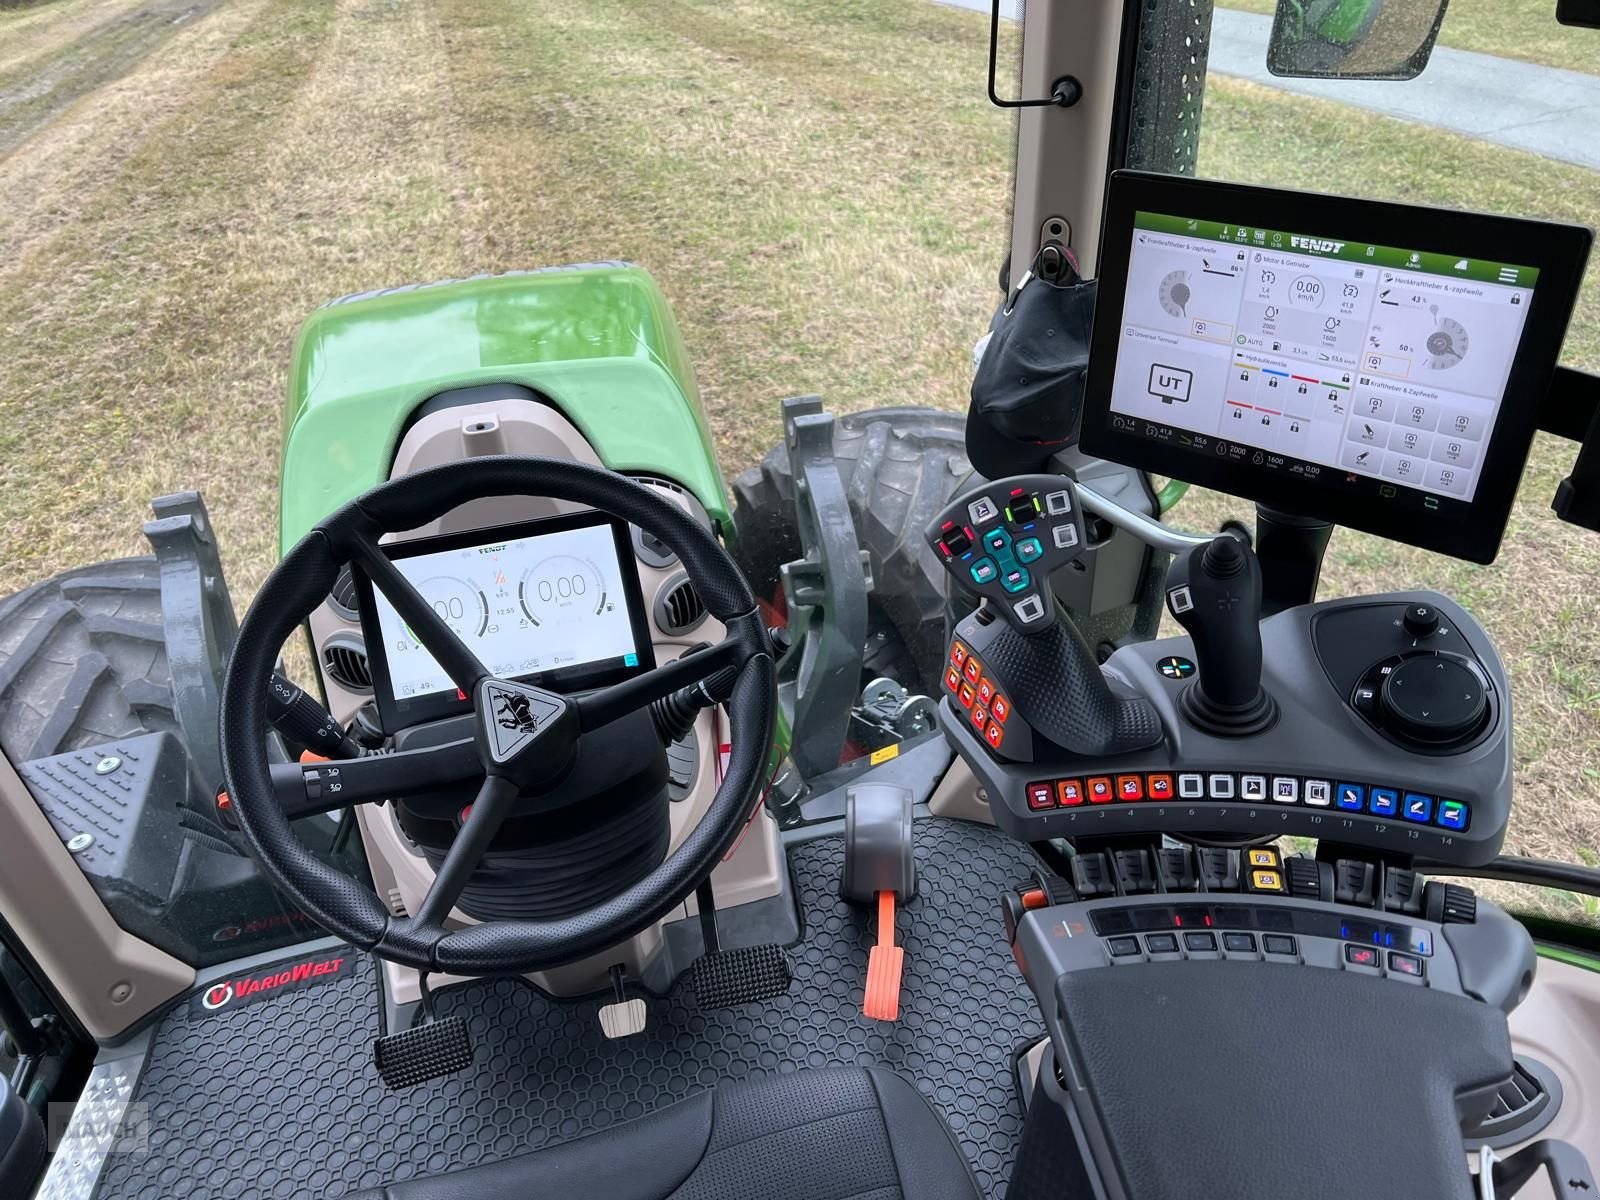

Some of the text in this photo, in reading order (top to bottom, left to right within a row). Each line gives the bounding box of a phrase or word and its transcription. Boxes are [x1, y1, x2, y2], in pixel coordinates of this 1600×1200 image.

[1290, 236, 1345, 254] FENDT
[1263, 256, 1279, 264] Motor
[1286, 260, 1310, 269] Getriebe
[1297, 281, 1320, 294] 0,00
[1395, 278, 1443, 291] Heckkraftheber
[1298, 294, 1314, 302] km/h
[1135, 331, 1179, 344] Universal Terminal
[1323, 334, 1337, 342] 1600
[1400, 344, 1408, 352] 50
[1245, 354, 1287, 368] Hydraulikventile
[1159, 375, 1182, 390] UT
[1371, 381, 1402, 393] Kraftheber
[1408, 388, 1439, 399] Zapfwelle
[1160, 428, 1172, 436] 41,8
[1194, 436, 1207, 445] 55,6
[1230, 445, 1246, 455] 2000
[1268, 456, 1284, 465] 1600
[478, 545, 508, 555] FENDT
[538, 574, 586, 603] 0,00
[496, 607, 515, 616] 12:55
[420, 682, 430, 690] 49
[1128, 809, 1134, 817] 4
[1160, 808, 1165, 816] 5
[1220, 809, 1226, 817] 7
[1250, 810, 1256, 818] 8
[1043, 816, 1047, 824] 1
[1281, 813, 1288, 821] 9
[1310, 816, 1321, 824] 10
[1343, 820, 1353, 828] 11
[1375, 825, 1386, 833] 12
[1408, 830, 1419, 839] 13
[1441, 836, 1452, 846] 14
